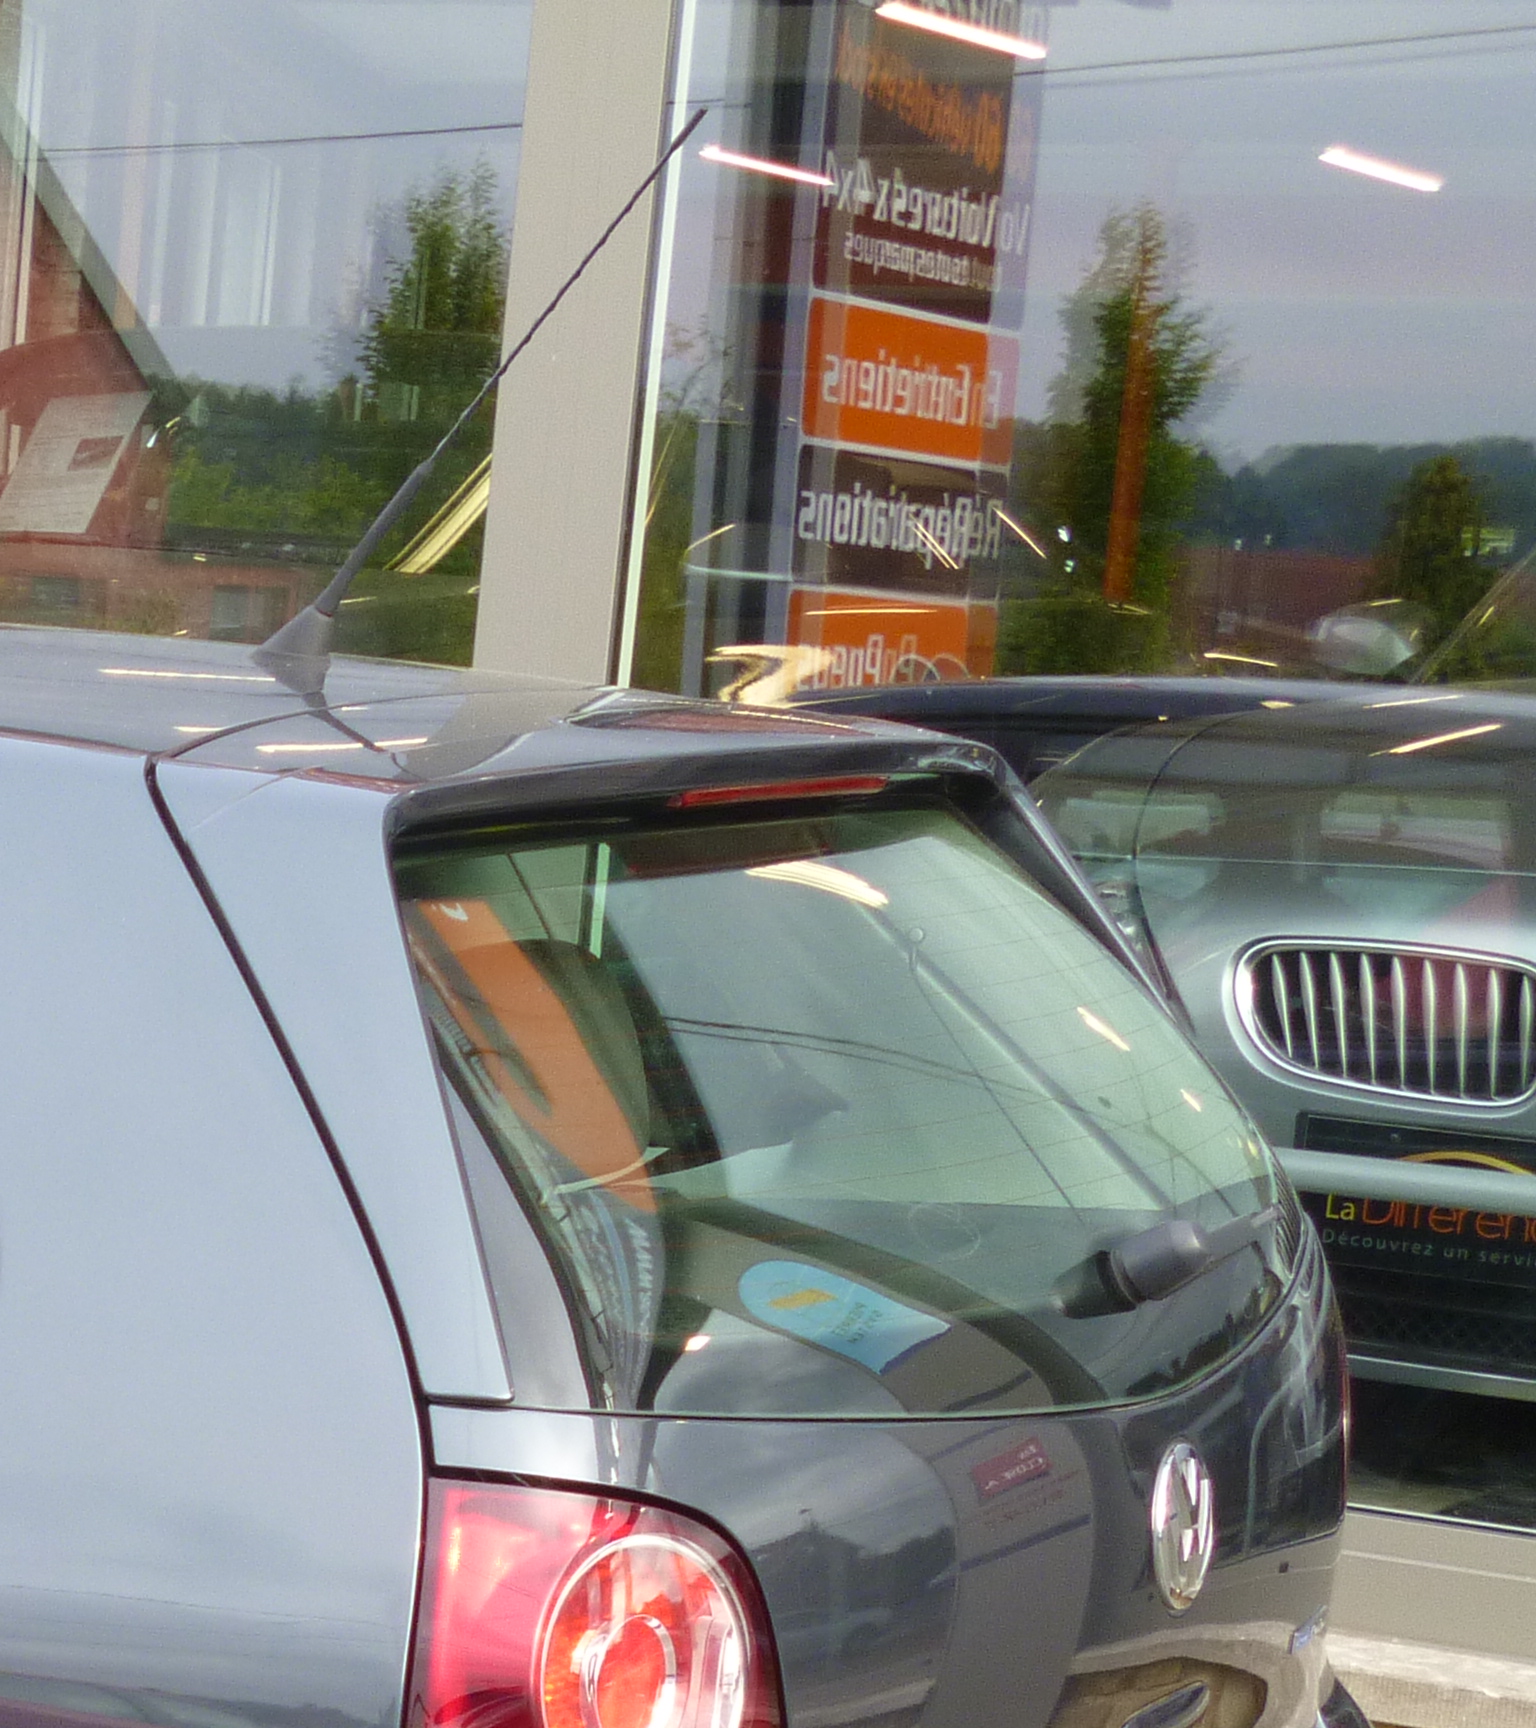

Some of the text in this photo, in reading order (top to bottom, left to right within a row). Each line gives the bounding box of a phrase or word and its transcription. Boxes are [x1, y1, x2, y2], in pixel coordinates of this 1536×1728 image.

[1325, 1192, 1356, 1221] La
[1322, 1229, 1536, 1269] Découvrez un servi
